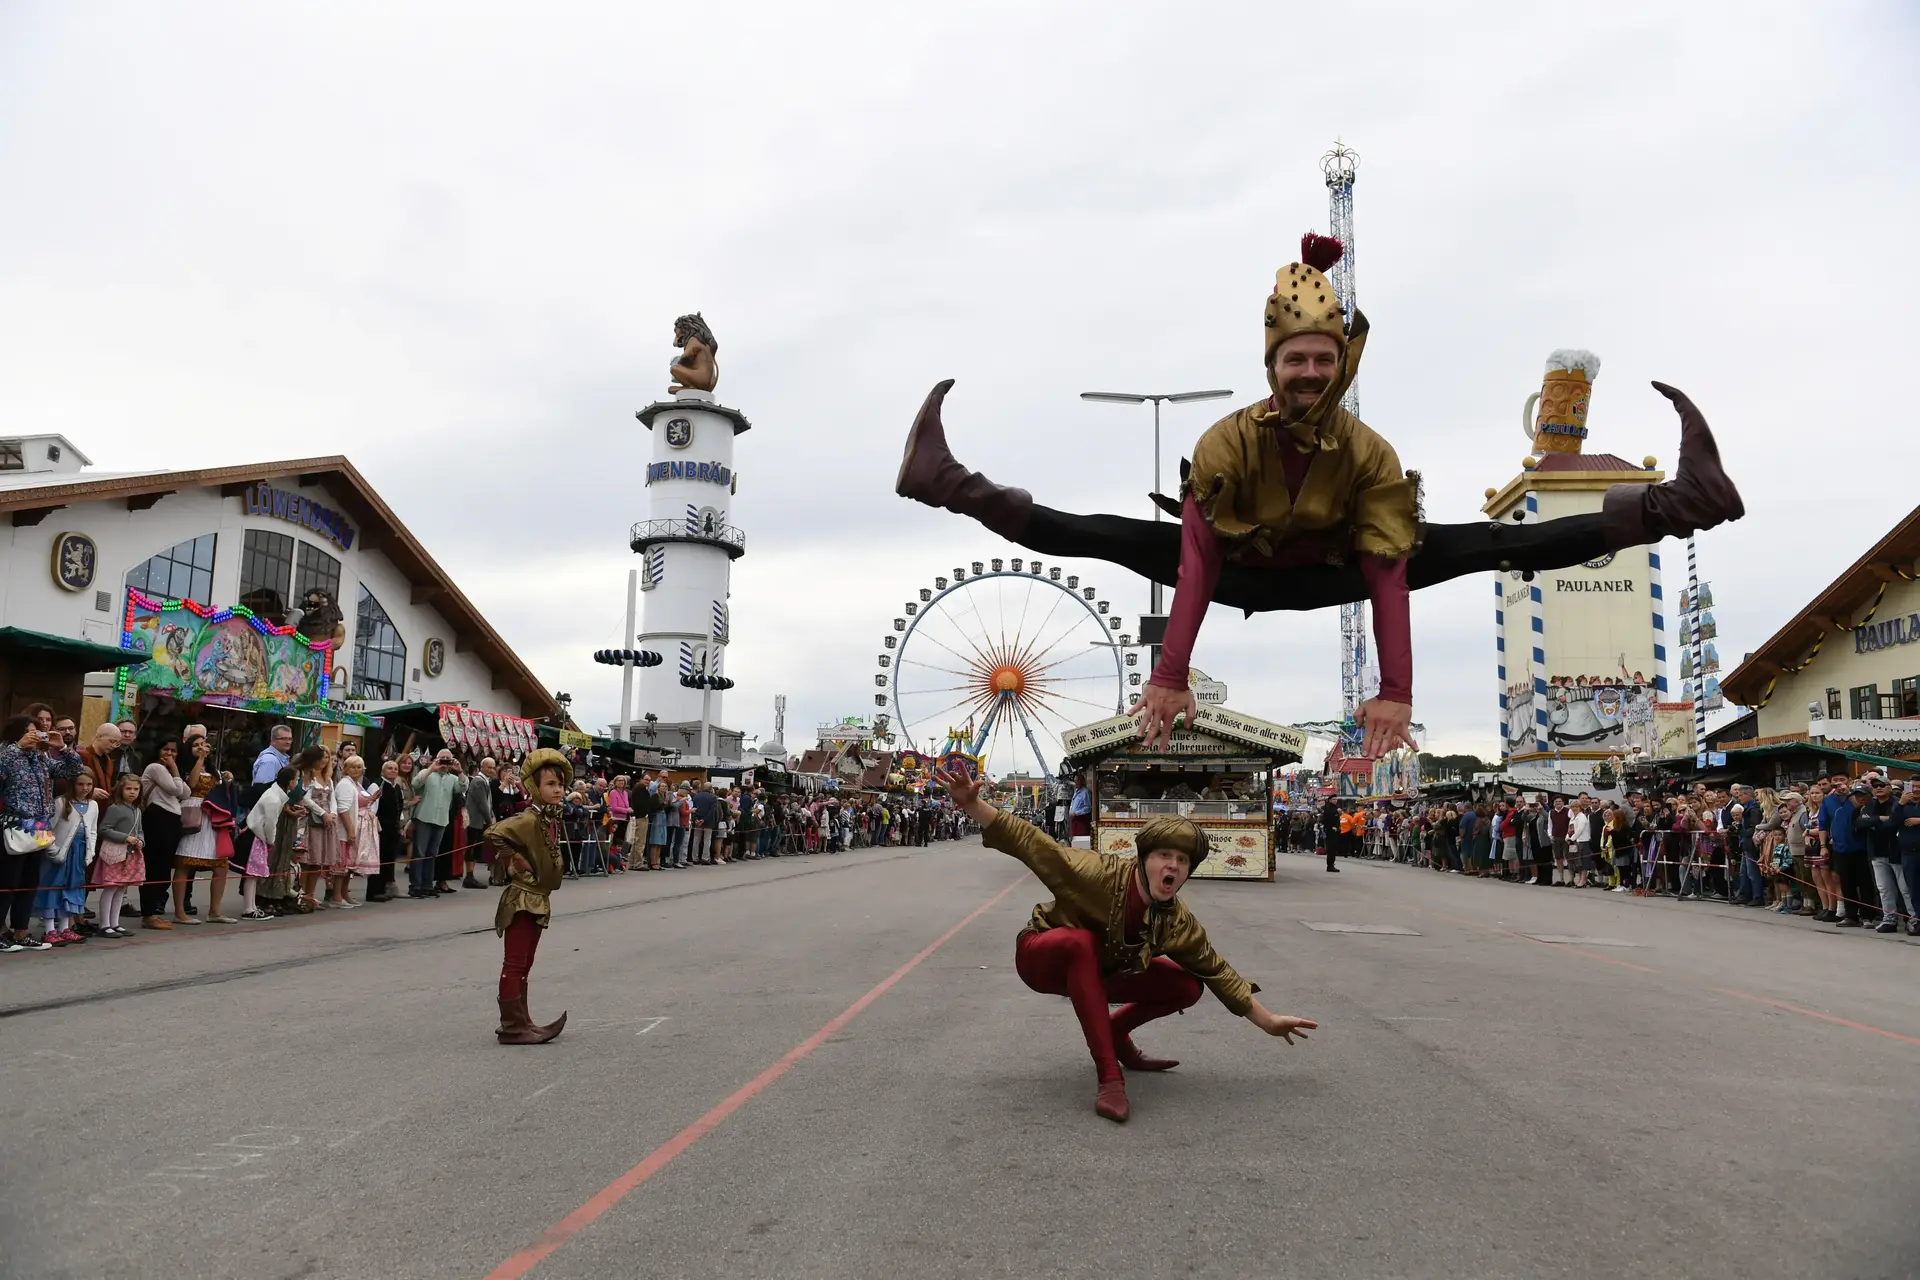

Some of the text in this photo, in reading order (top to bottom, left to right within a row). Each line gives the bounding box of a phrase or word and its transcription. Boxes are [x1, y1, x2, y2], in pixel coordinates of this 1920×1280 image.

[1506, 584, 1530, 608] PAULANER
[1556, 579, 1634, 592] PAULANER
[1069, 734, 1090, 749] gebr.
[1090, 725, 1117, 740] Nüsse
[1118, 720, 1133, 733] aus
[1216, 713, 1243, 730] Nüsse
[1243, 724, 1259, 735] aus
[1260, 728, 1280, 741] aller
[1280, 732, 1301, 748] Welt
[1141, 742, 1226, 752] Madelbrennerei
